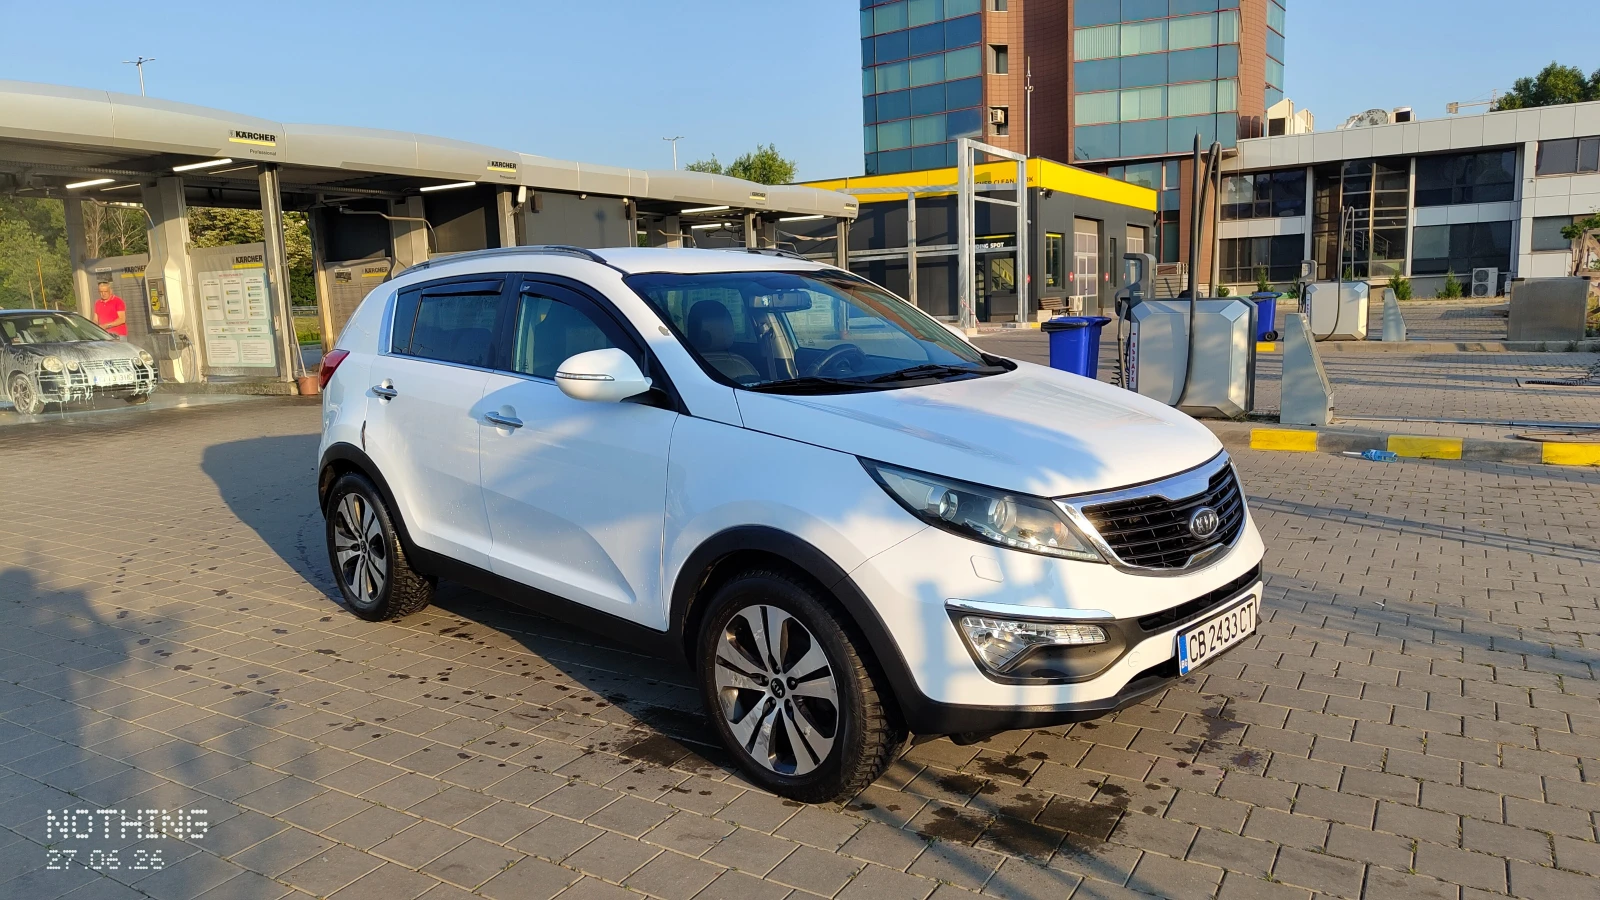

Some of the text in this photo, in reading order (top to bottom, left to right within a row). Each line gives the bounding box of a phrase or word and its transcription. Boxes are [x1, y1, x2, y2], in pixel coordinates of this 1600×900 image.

[236, 131, 276, 142] KÄRCHER
[1190, 602, 1253, 662] CB 2433 CT
